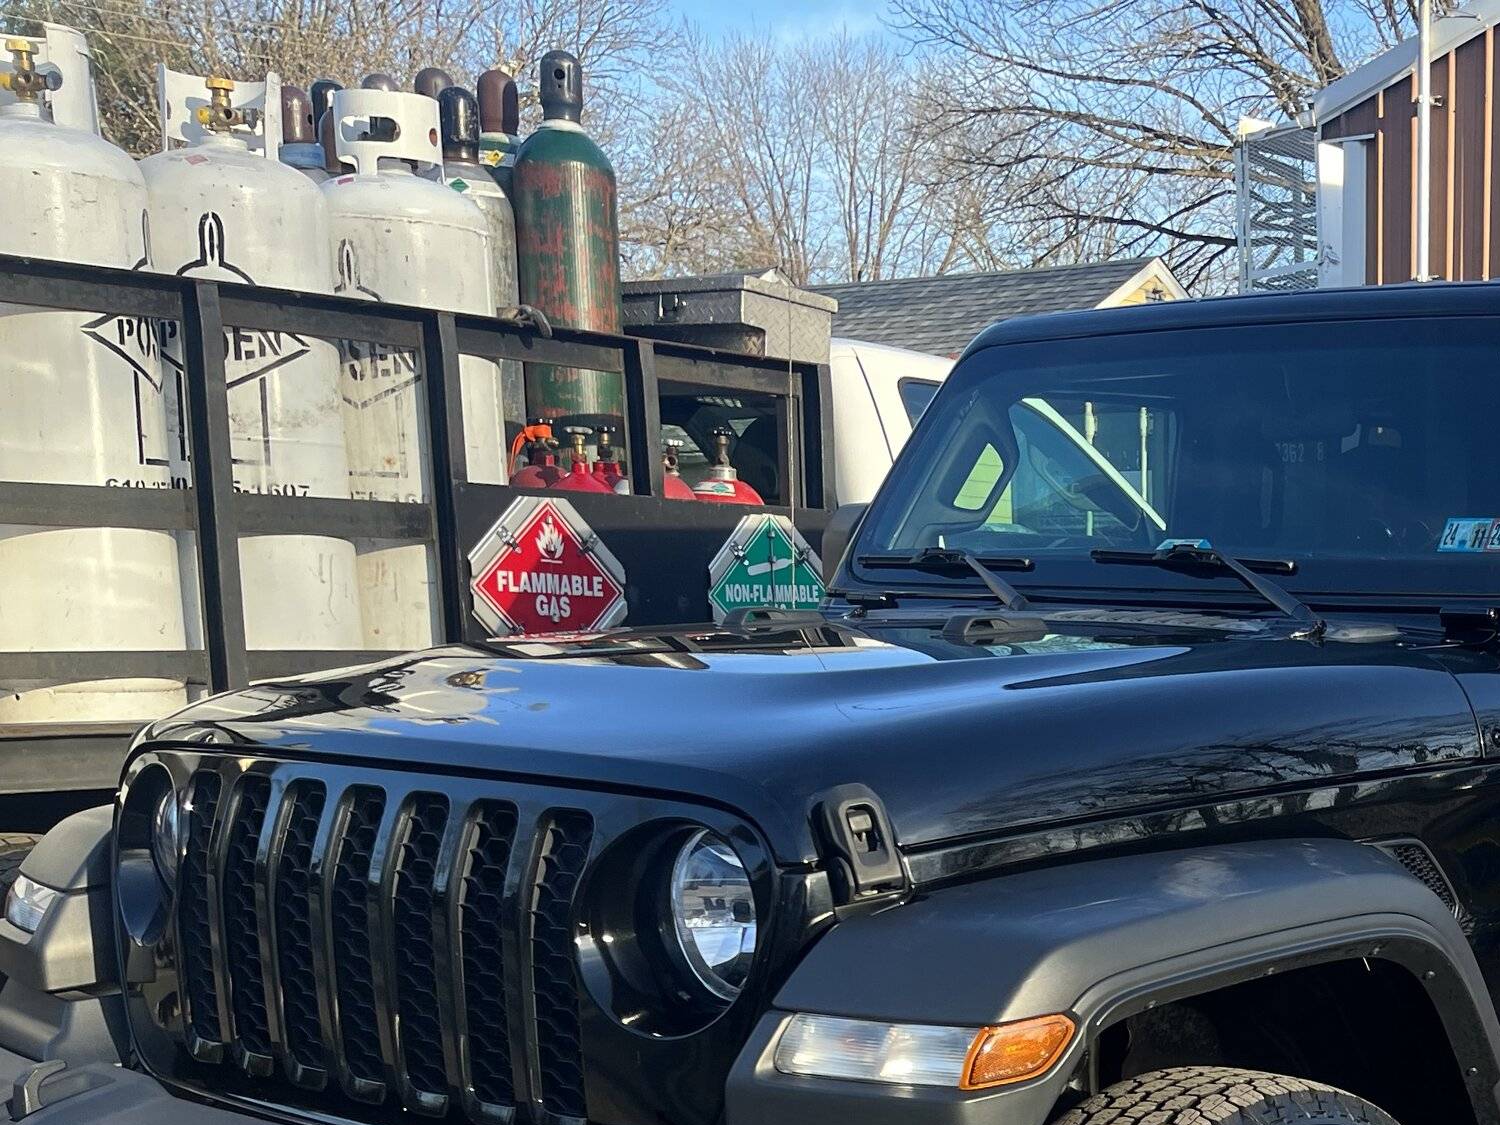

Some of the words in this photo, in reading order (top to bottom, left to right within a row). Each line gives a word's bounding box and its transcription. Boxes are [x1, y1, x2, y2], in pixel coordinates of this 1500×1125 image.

[1443, 523, 1460, 546] 24
[1471, 528, 1487, 549] 11
[496, 570, 604, 597] FLAMMABLE
[725, 584, 819, 603] NON-FLAMMABLE
[535, 595, 571, 618] GAS
